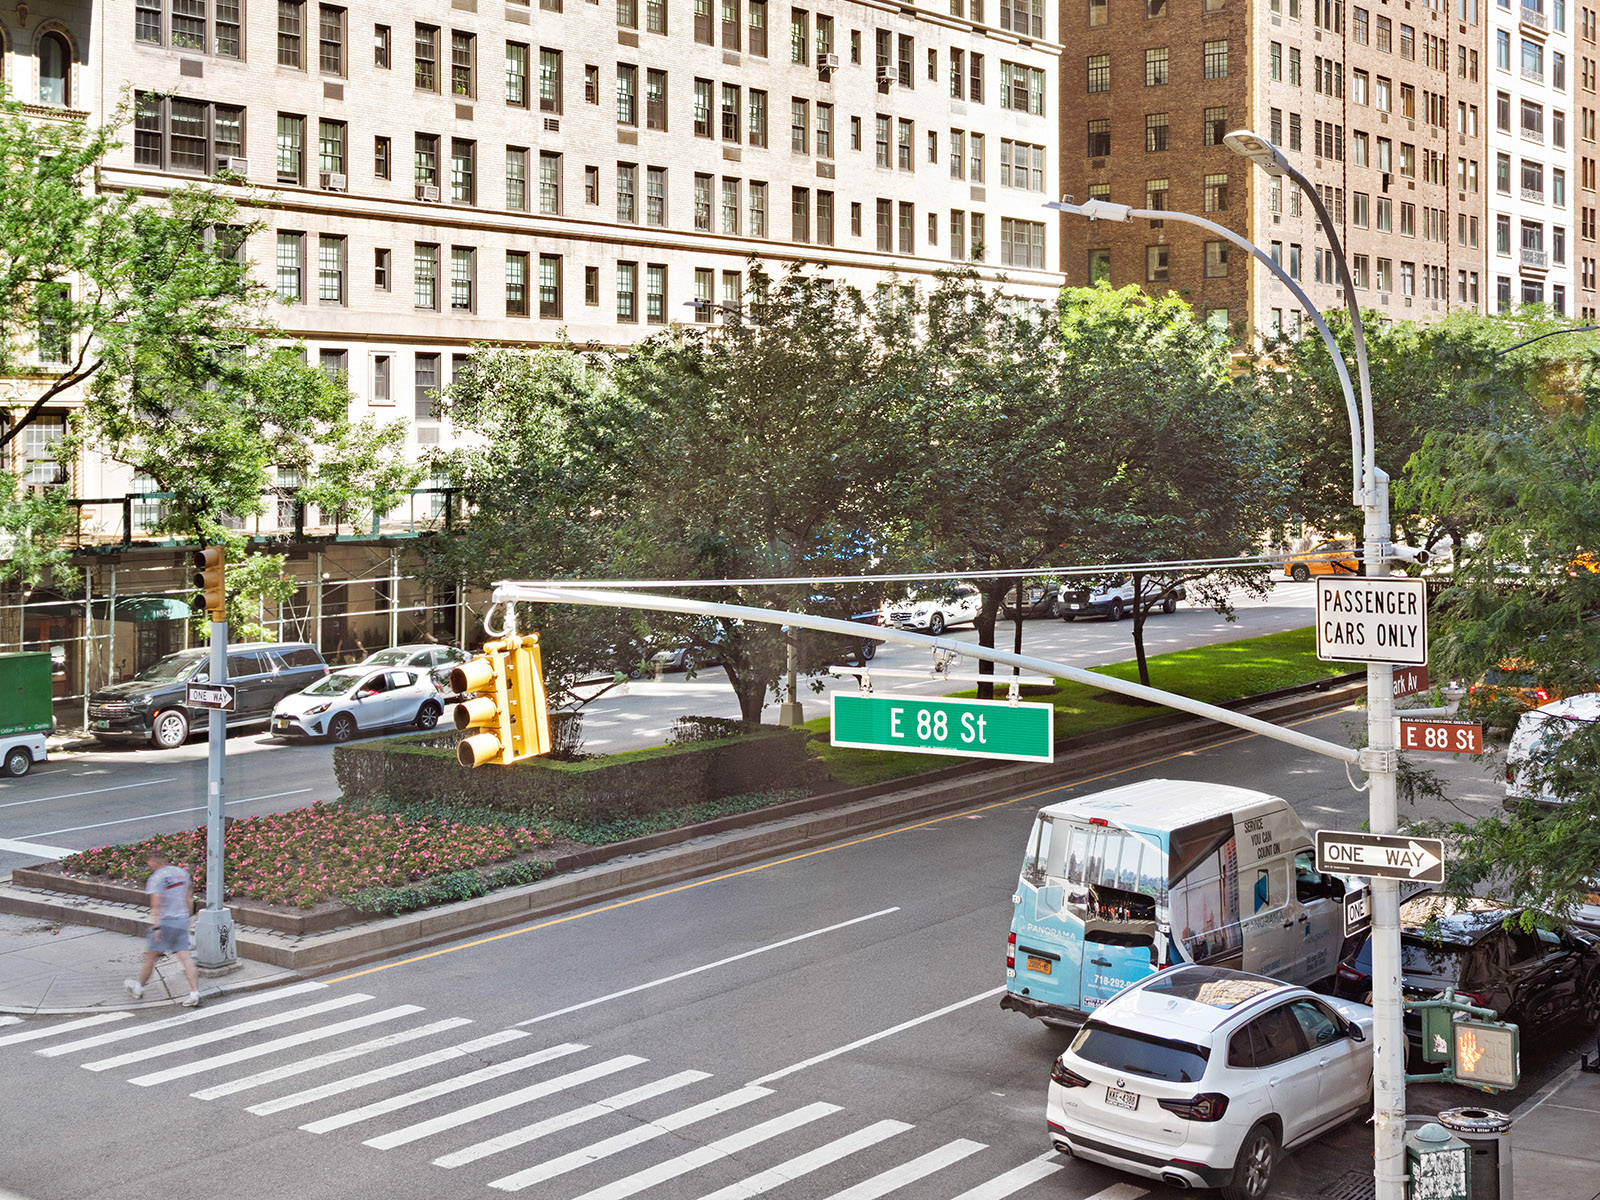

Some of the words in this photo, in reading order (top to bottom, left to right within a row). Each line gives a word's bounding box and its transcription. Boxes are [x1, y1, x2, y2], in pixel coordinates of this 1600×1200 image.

[1324, 590, 1417, 615] PASSENGER
[1325, 621, 1365, 645] CARS
[1377, 624, 1418, 648] ONLY
[1393, 675, 1406, 695] ark
[1408, 672, 1417, 691] Av
[193, 690, 207, 701] ONE
[213, 692, 228, 702] WAY
[891, 708, 904, 738] E
[917, 709, 948, 741] 88
[960, 712, 987, 744] St
[1407, 727, 1418, 746] E
[1425, 728, 1448, 748] 88
[1456, 729, 1475, 750] St
[1244, 818, 1264, 834] SERVICE
[1251, 832, 1262, 846] YOU
[1262, 830, 1272, 844] CAN
[1257, 844, 1274, 860] COUNT
[1273, 842, 1281, 855] ON
[1328, 845, 1364, 863] ONE
[1385, 849, 1425, 868] WAY
[1349, 901, 1365, 921] ONE
[1026, 922, 1077, 940] PANORAMA
